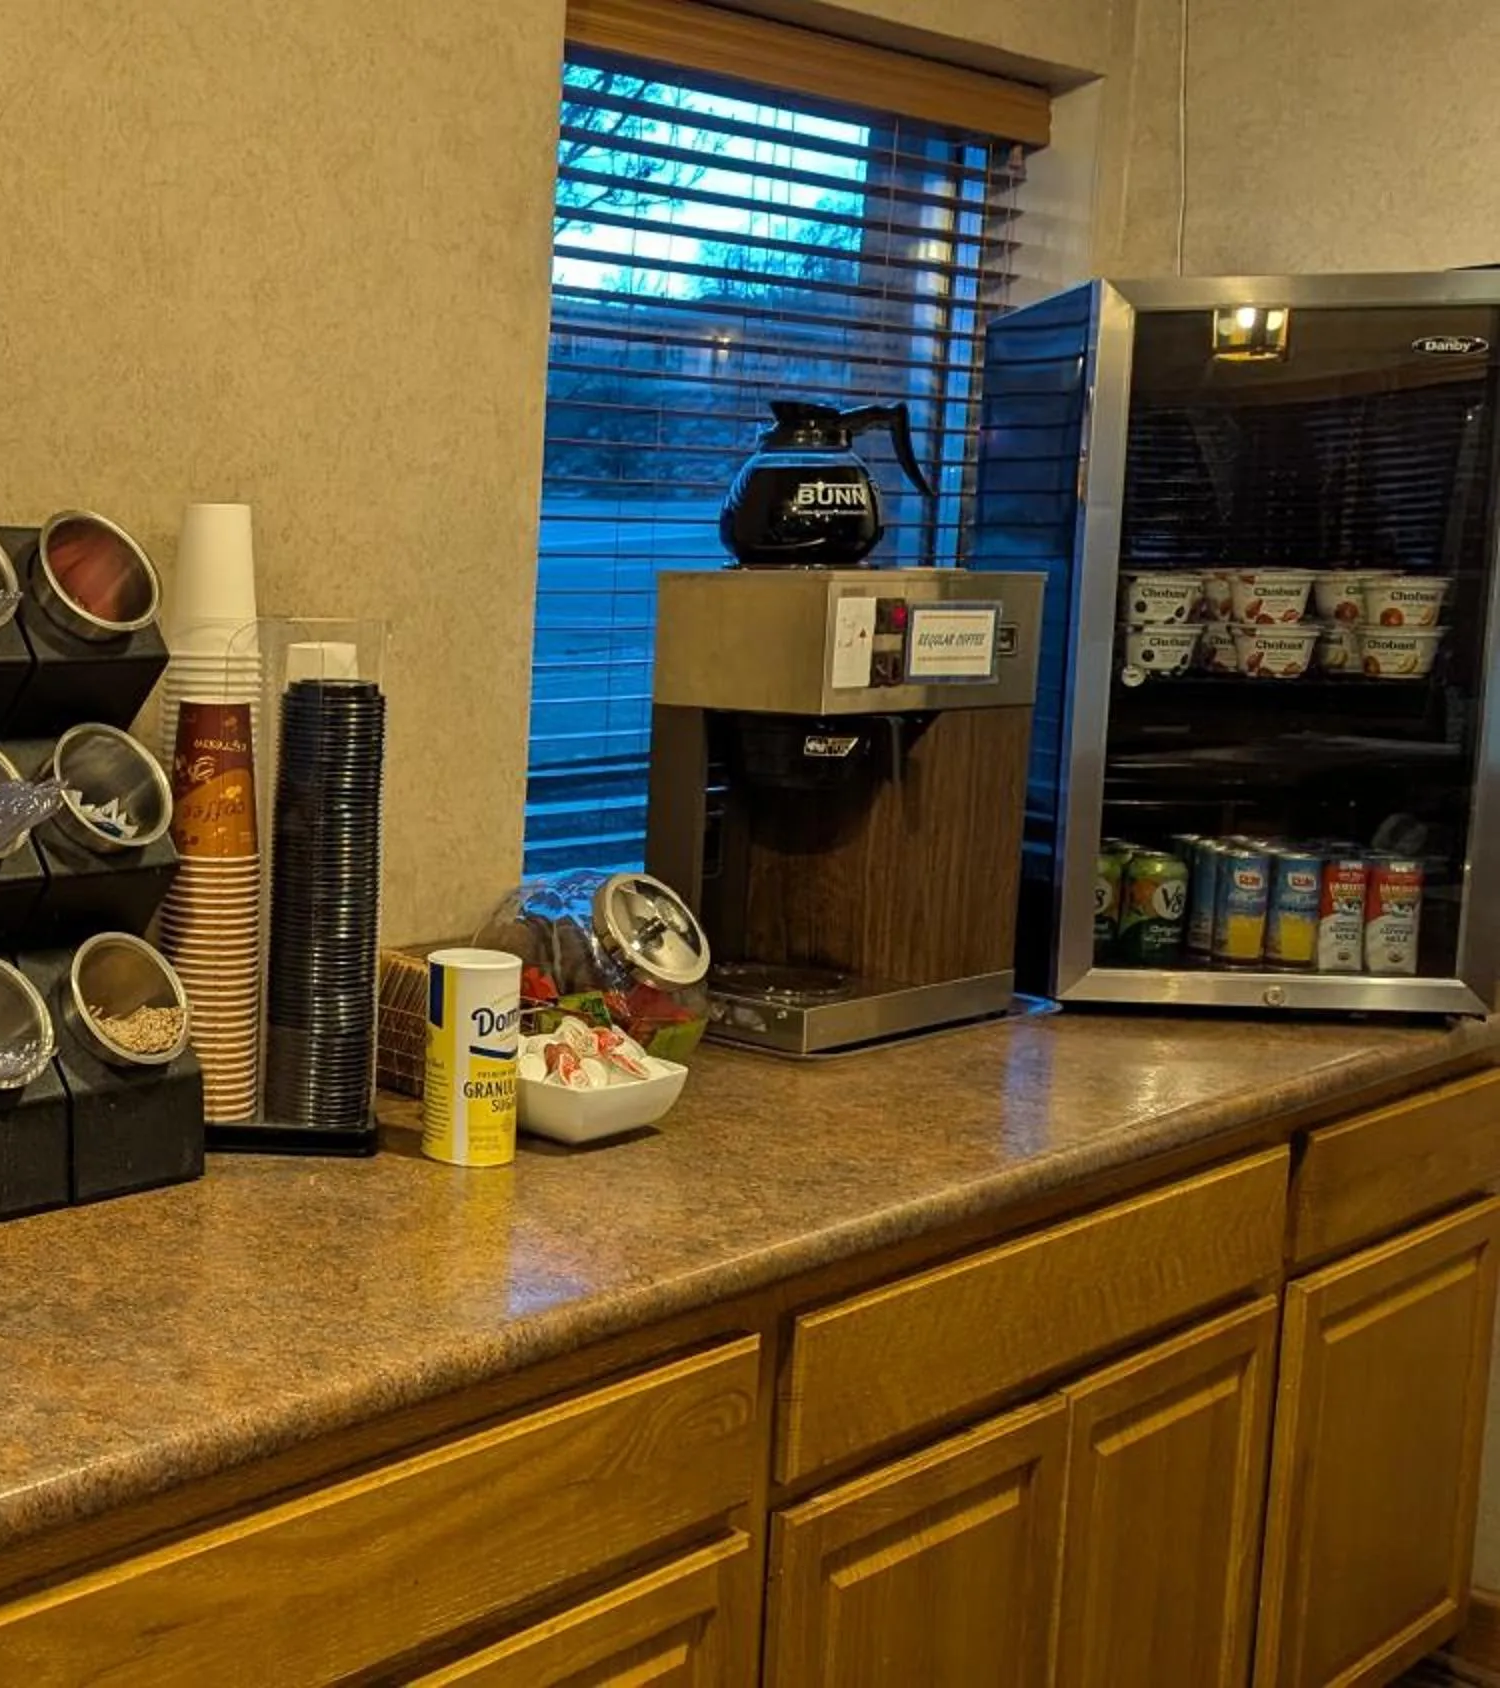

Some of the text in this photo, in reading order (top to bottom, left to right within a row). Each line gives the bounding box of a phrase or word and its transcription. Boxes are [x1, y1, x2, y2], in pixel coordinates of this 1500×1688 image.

[1424, 340, 1471, 353] Danby
[798, 488, 867, 505] BUNN
[955, 632, 986, 648] COFFEE
[1161, 884, 1184, 914] V8
